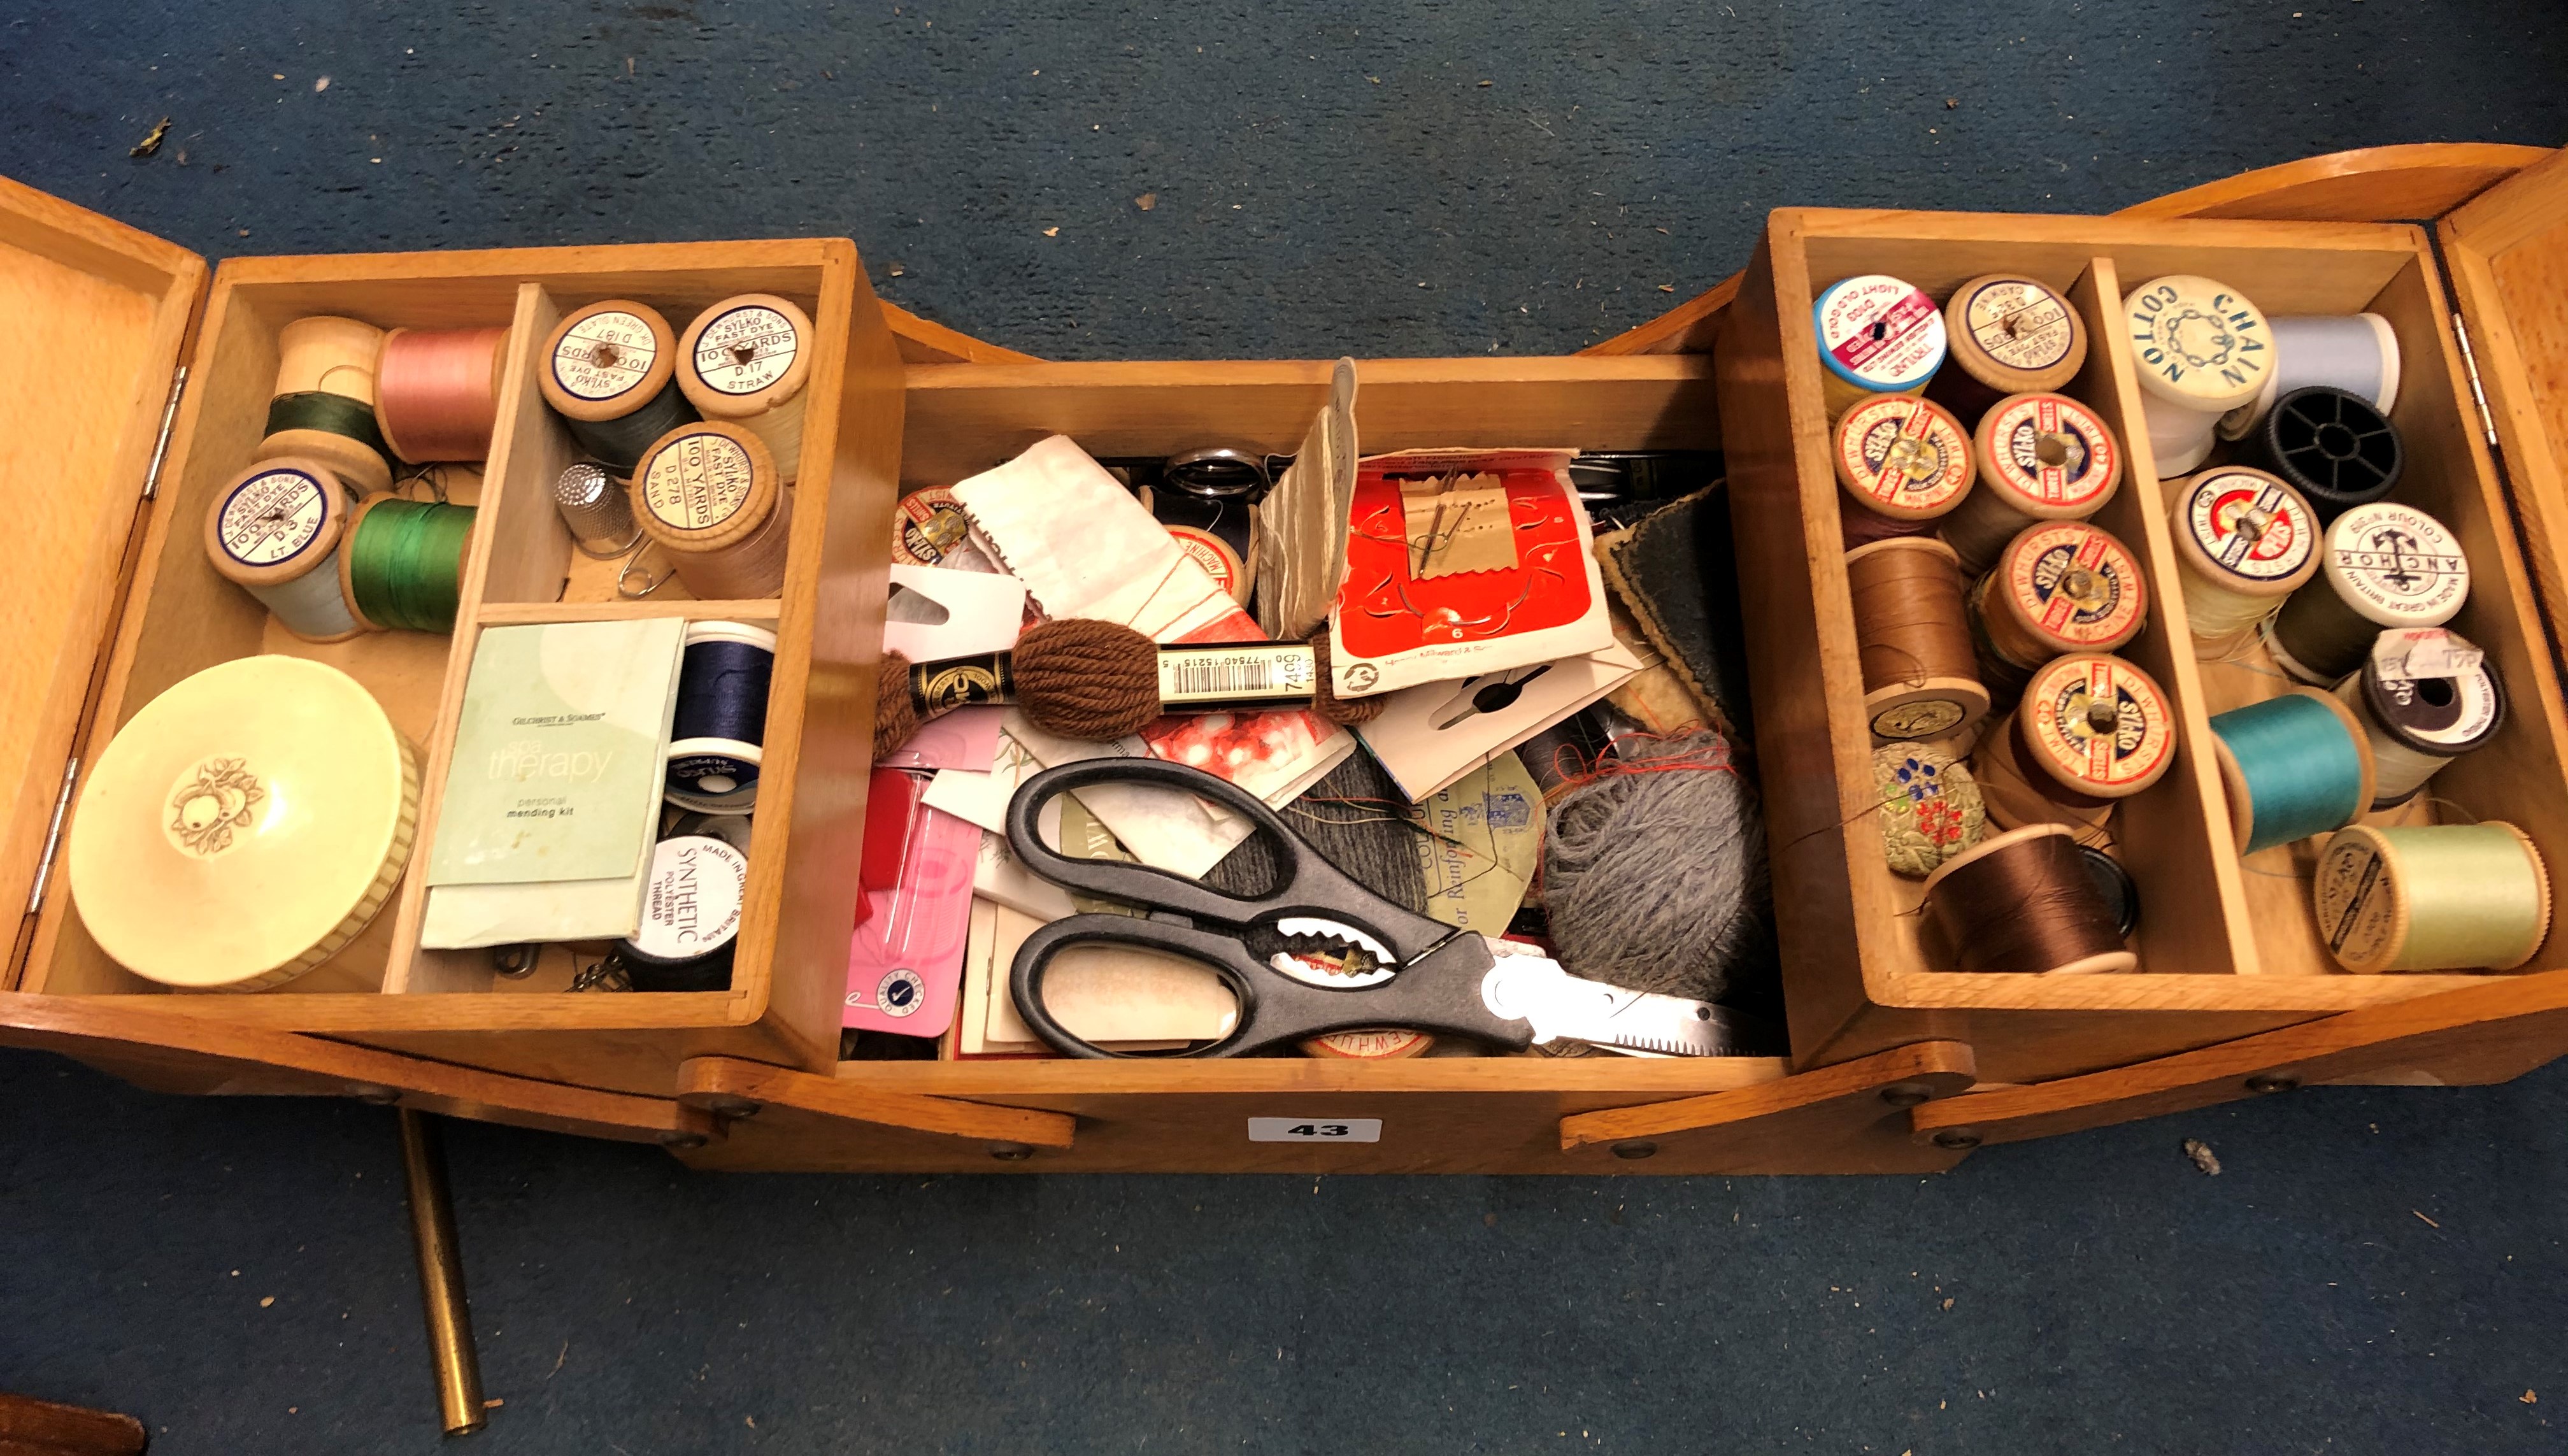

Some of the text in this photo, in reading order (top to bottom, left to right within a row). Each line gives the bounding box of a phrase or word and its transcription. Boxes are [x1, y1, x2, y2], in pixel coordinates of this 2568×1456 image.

[613, 317, 643, 333] GREEN
[724, 317, 761, 332] SYLKO
[766, 313, 787, 329] SONS
[1829, 284, 1899, 339] LIGHT OLD GOLD
[2033, 308, 2062, 324] 100
[715, 329, 746, 342] FAST
[750, 323, 774, 333] DYE
[2134, 285, 2185, 382] COTTON
[2213, 294, 2265, 388] CHAIN
[617, 357, 647, 369] 100
[727, 370, 774, 389] STRAW
[711, 448, 724, 477] FAST
[723, 457, 738, 492] SYLKO
[650, 470, 665, 509] SAND
[688, 440, 710, 525] 100 YARDS
[717, 482, 728, 504] DYE
[234, 484, 285, 527] FAST DYE
[238, 487, 270, 515] SYLKO
[231, 524, 261, 550] 100
[292, 517, 318, 548] BLUE
[2388, 511, 2443, 543] COLOUR
[1186, 542, 1223, 571] MACHINE
[2341, 552, 2458, 571] ANCHOR
[2347, 571, 2385, 604] BRITAIN
[2388, 601, 2426, 611] GREAT
[1452, 628, 1463, 639] 6
[1184, 658, 1219, 666] 15215
[1225, 657, 1259, 665] 77540
[1283, 654, 1302, 692] 7499
[509, 739, 541, 755] spa
[489, 751, 612, 783] therapy
[507, 807, 574, 818] mending kit
[517, 796, 566, 808] personal
[703, 845, 733, 862] MADE
[732, 860, 743, 873] IN
[1441, 809, 1467, 899] Reinfoing
[652, 880, 662, 921] THREAD
[664, 871, 674, 927] POLYESTER
[677, 848, 698, 944] SYNTHETIC
[702, 909, 741, 942] BRITAIN
[1457, 908, 1469, 925] or
[879, 972, 922, 1014] QUALITY CHECKED
[1287, 1124, 1349, 1136] 43
